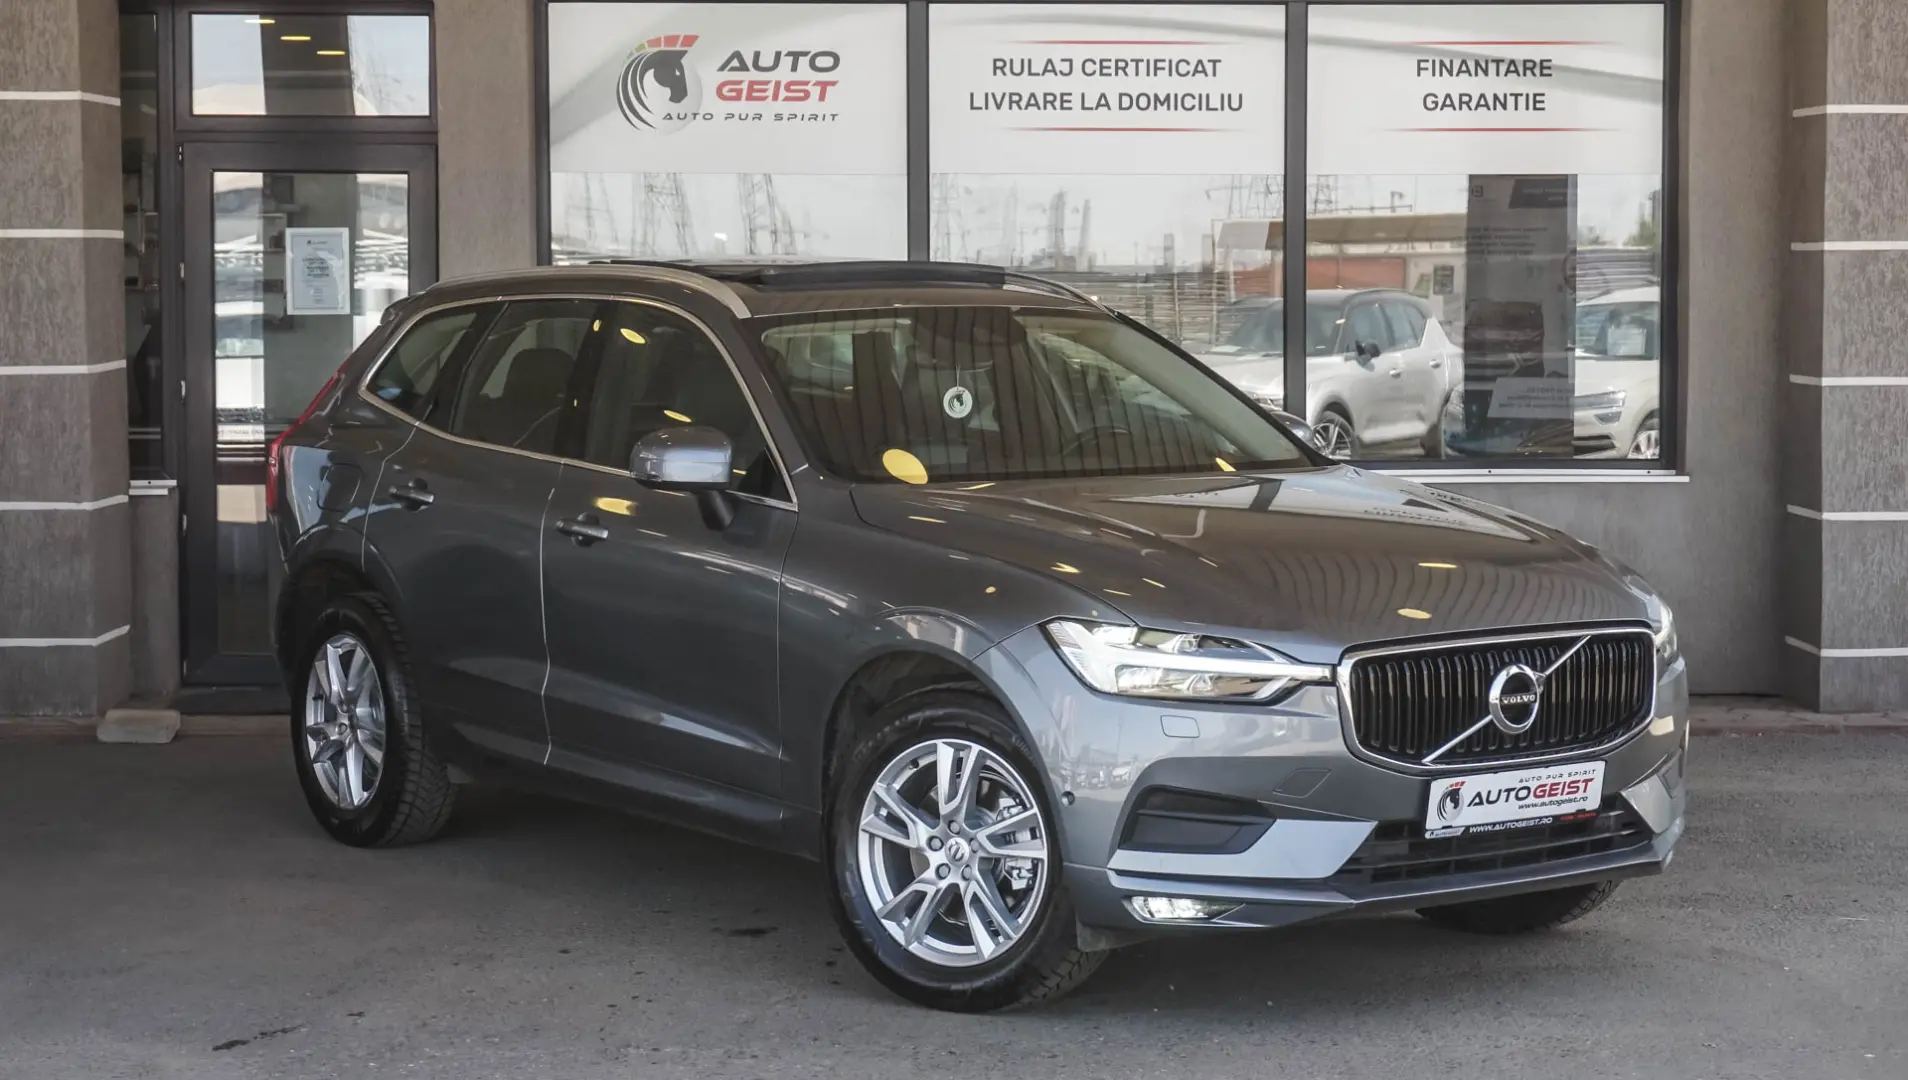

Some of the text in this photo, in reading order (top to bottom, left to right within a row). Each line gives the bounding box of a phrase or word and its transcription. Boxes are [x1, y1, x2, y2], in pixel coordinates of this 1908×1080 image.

[716, 50, 841, 73] AUTO
[992, 58, 1222, 78] RULAJ CERTIFICAT
[1416, 59, 1553, 77] FINANTARE
[715, 79, 840, 103] GEIST
[969, 92, 1243, 112] LIVRARE LA DOMICILIU
[1422, 92, 1546, 111] GARANTIE
[662, 112, 840, 122] AUTO PUR SPIRIT
[1501, 694, 1536, 704] VOLVO
[1518, 775, 1542, 783] AUTO
[1567, 769, 1597, 778] SPIRIT
[1467, 777, 1595, 807] AUTOGEIST
[1517, 795, 1588, 810] www.autogeist.ro
[1469, 817, 1553, 833] WWW.AUTOGEIST.RO
